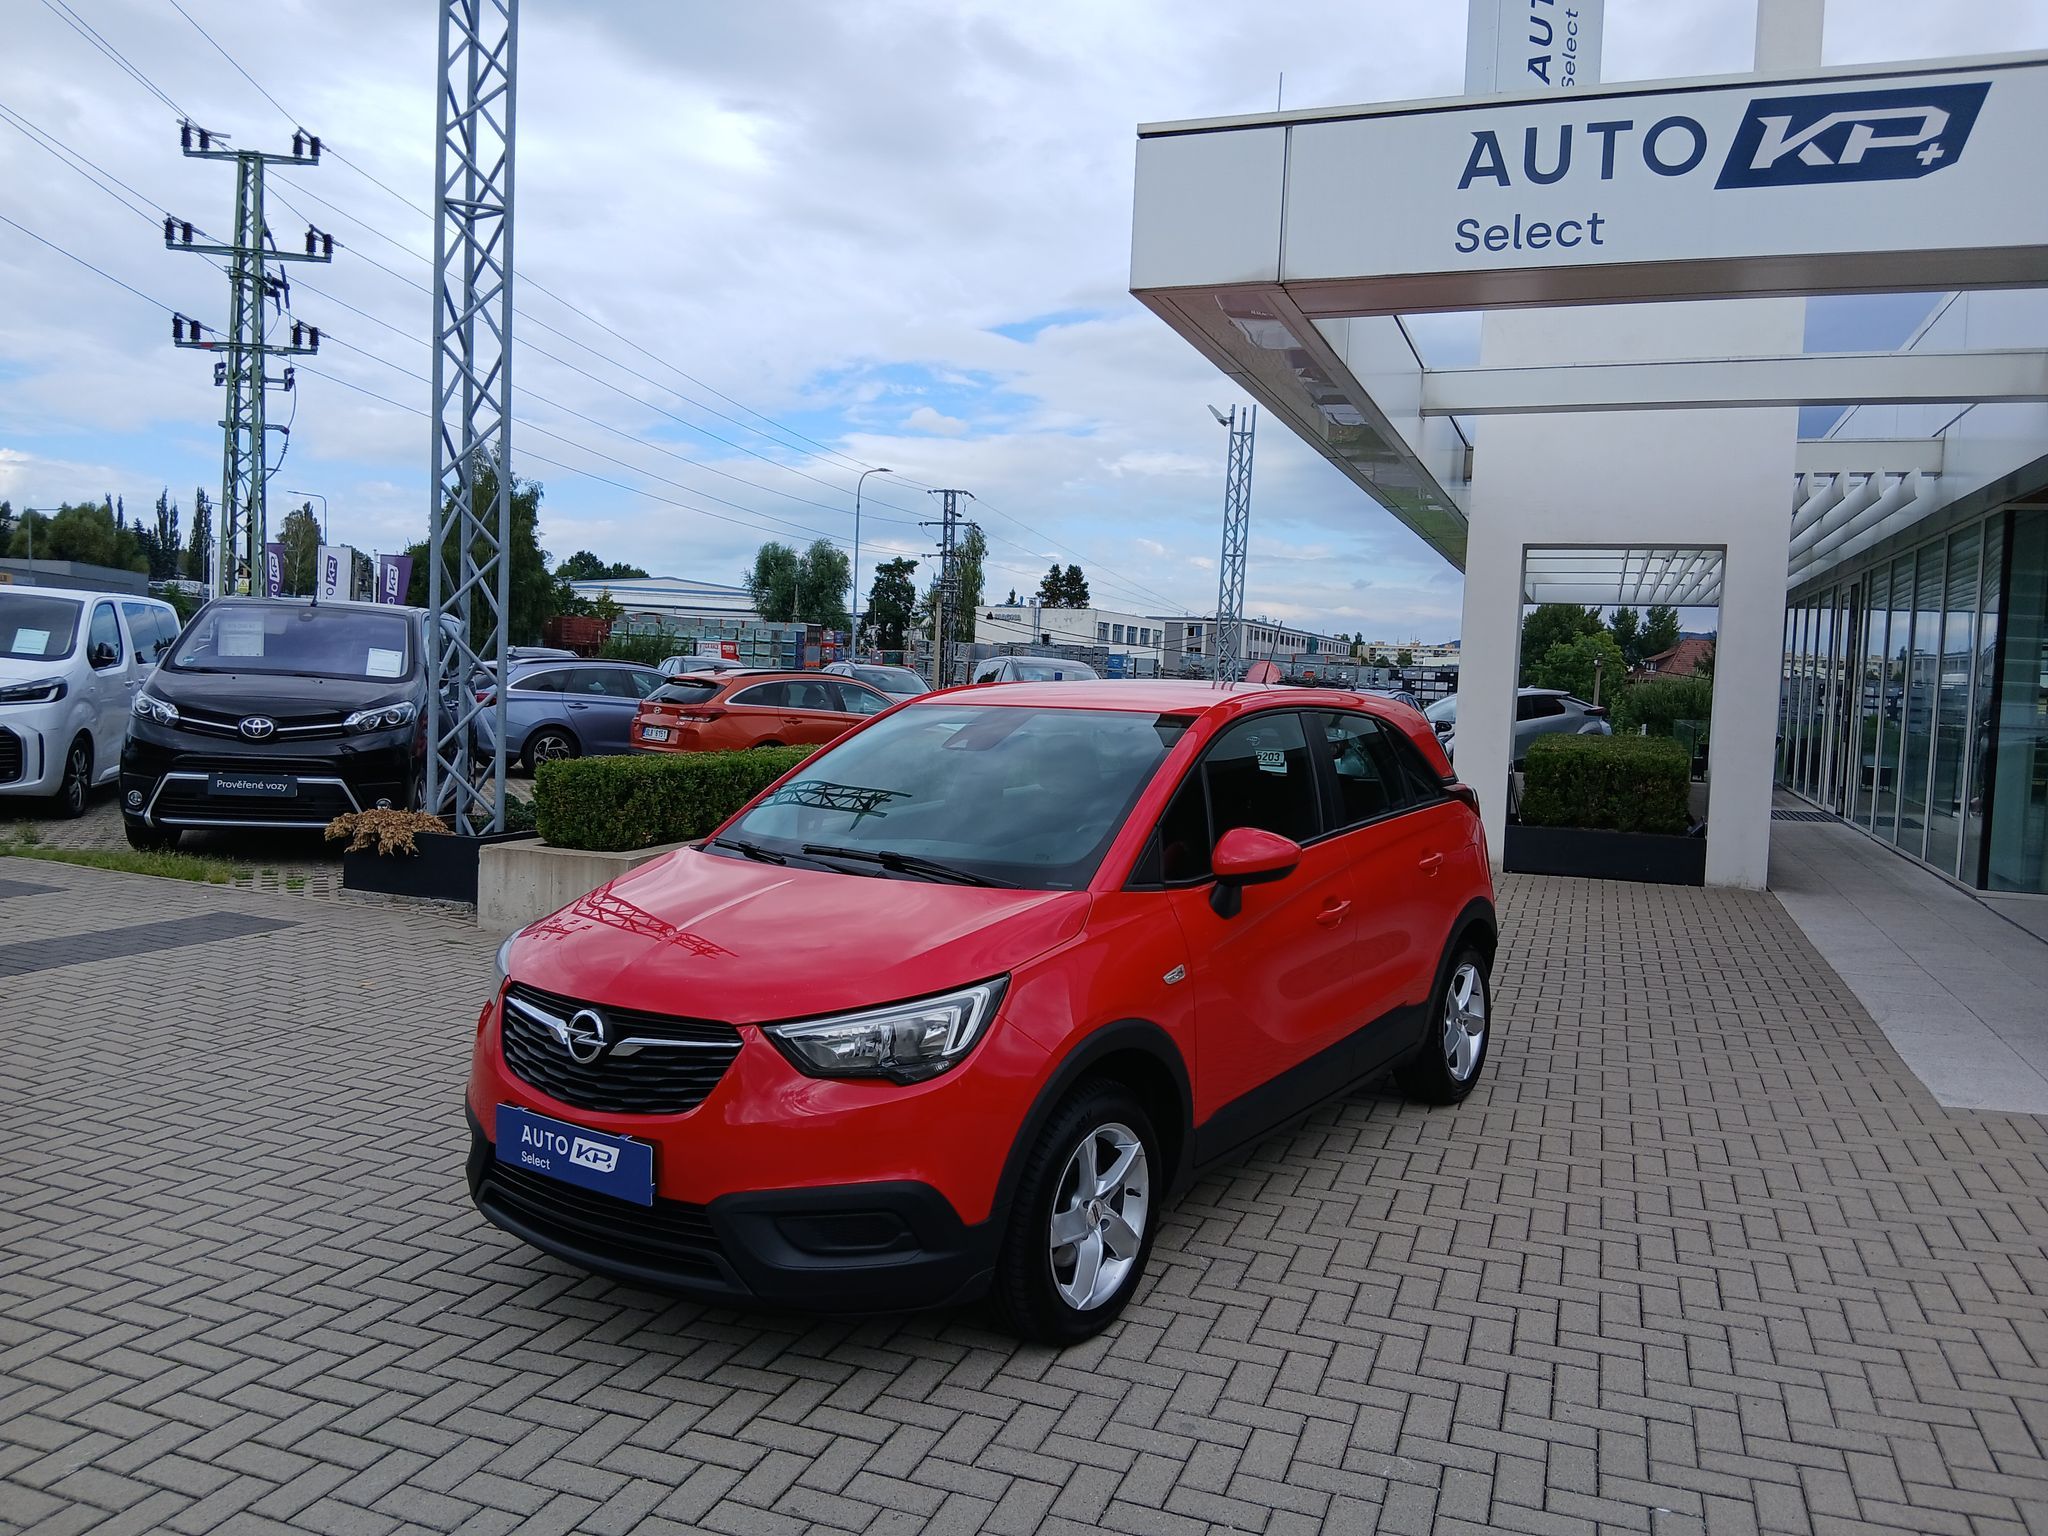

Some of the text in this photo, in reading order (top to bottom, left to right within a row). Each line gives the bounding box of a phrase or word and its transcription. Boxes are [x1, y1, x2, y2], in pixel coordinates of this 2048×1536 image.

[1561, 8, 1579, 87] Select
[1457, 115, 1708, 190] AUTO
[1454, 212, 1605, 254] Select
[1257, 751, 1281, 762] 5203
[216, 779, 288, 793] Prověřené vozy
[521, 1124, 569, 1156] AUTO
[521, 1150, 551, 1171] Select
